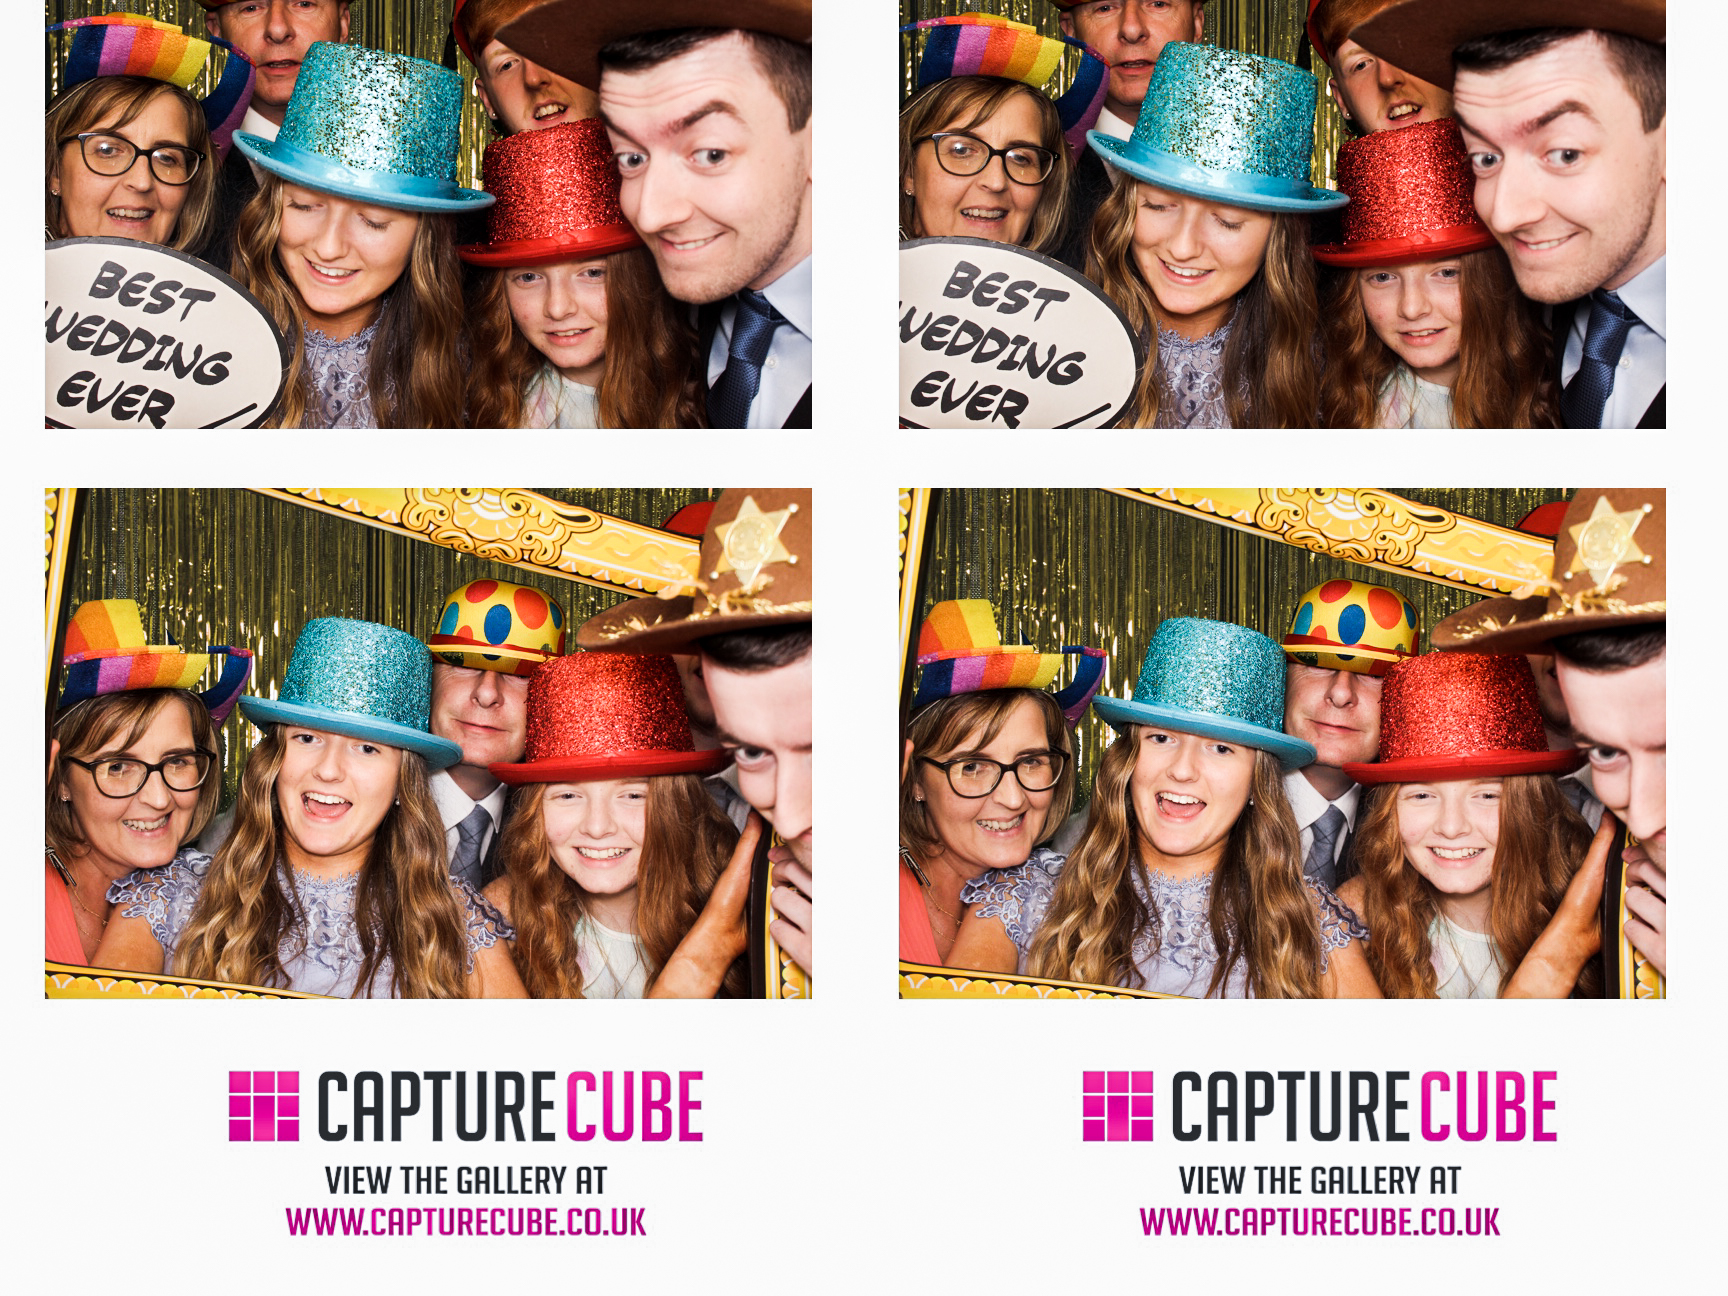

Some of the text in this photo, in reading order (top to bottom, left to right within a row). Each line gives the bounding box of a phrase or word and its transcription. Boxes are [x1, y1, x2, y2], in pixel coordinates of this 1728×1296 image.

[88, 260, 217, 322] BEST
[942, 260, 1071, 322] BEST
[56, 370, 176, 430] EVER
[910, 370, 1030, 430] EVER
